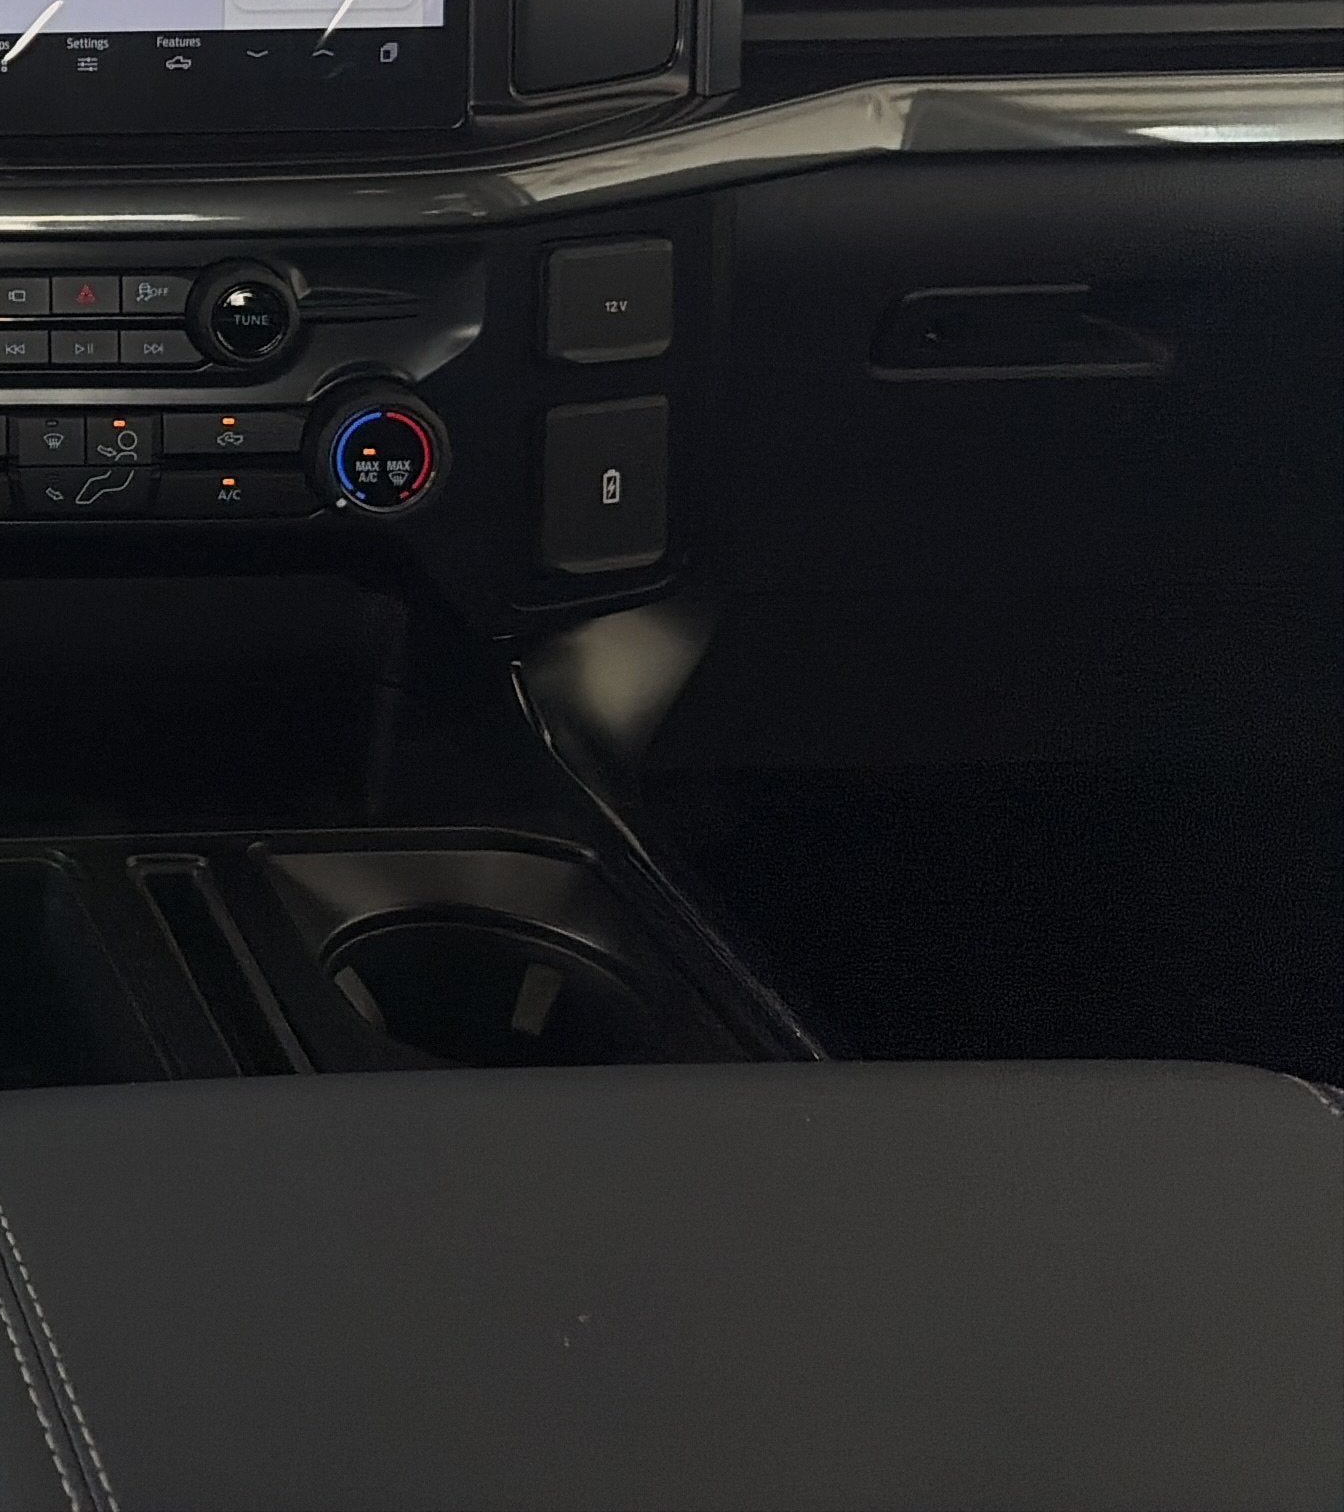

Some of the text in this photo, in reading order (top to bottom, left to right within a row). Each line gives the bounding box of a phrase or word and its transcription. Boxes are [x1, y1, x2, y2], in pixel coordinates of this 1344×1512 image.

[66, 37, 110, 52] Settings
[156, 35, 202, 49] Features
[151, 288, 169, 297] OFF
[234, 314, 269, 326] TUNE
[355, 461, 380, 472] MAX
[387, 460, 411, 472] MAX
[359, 473, 378, 483] A/C
[218, 490, 241, 501] A/C
